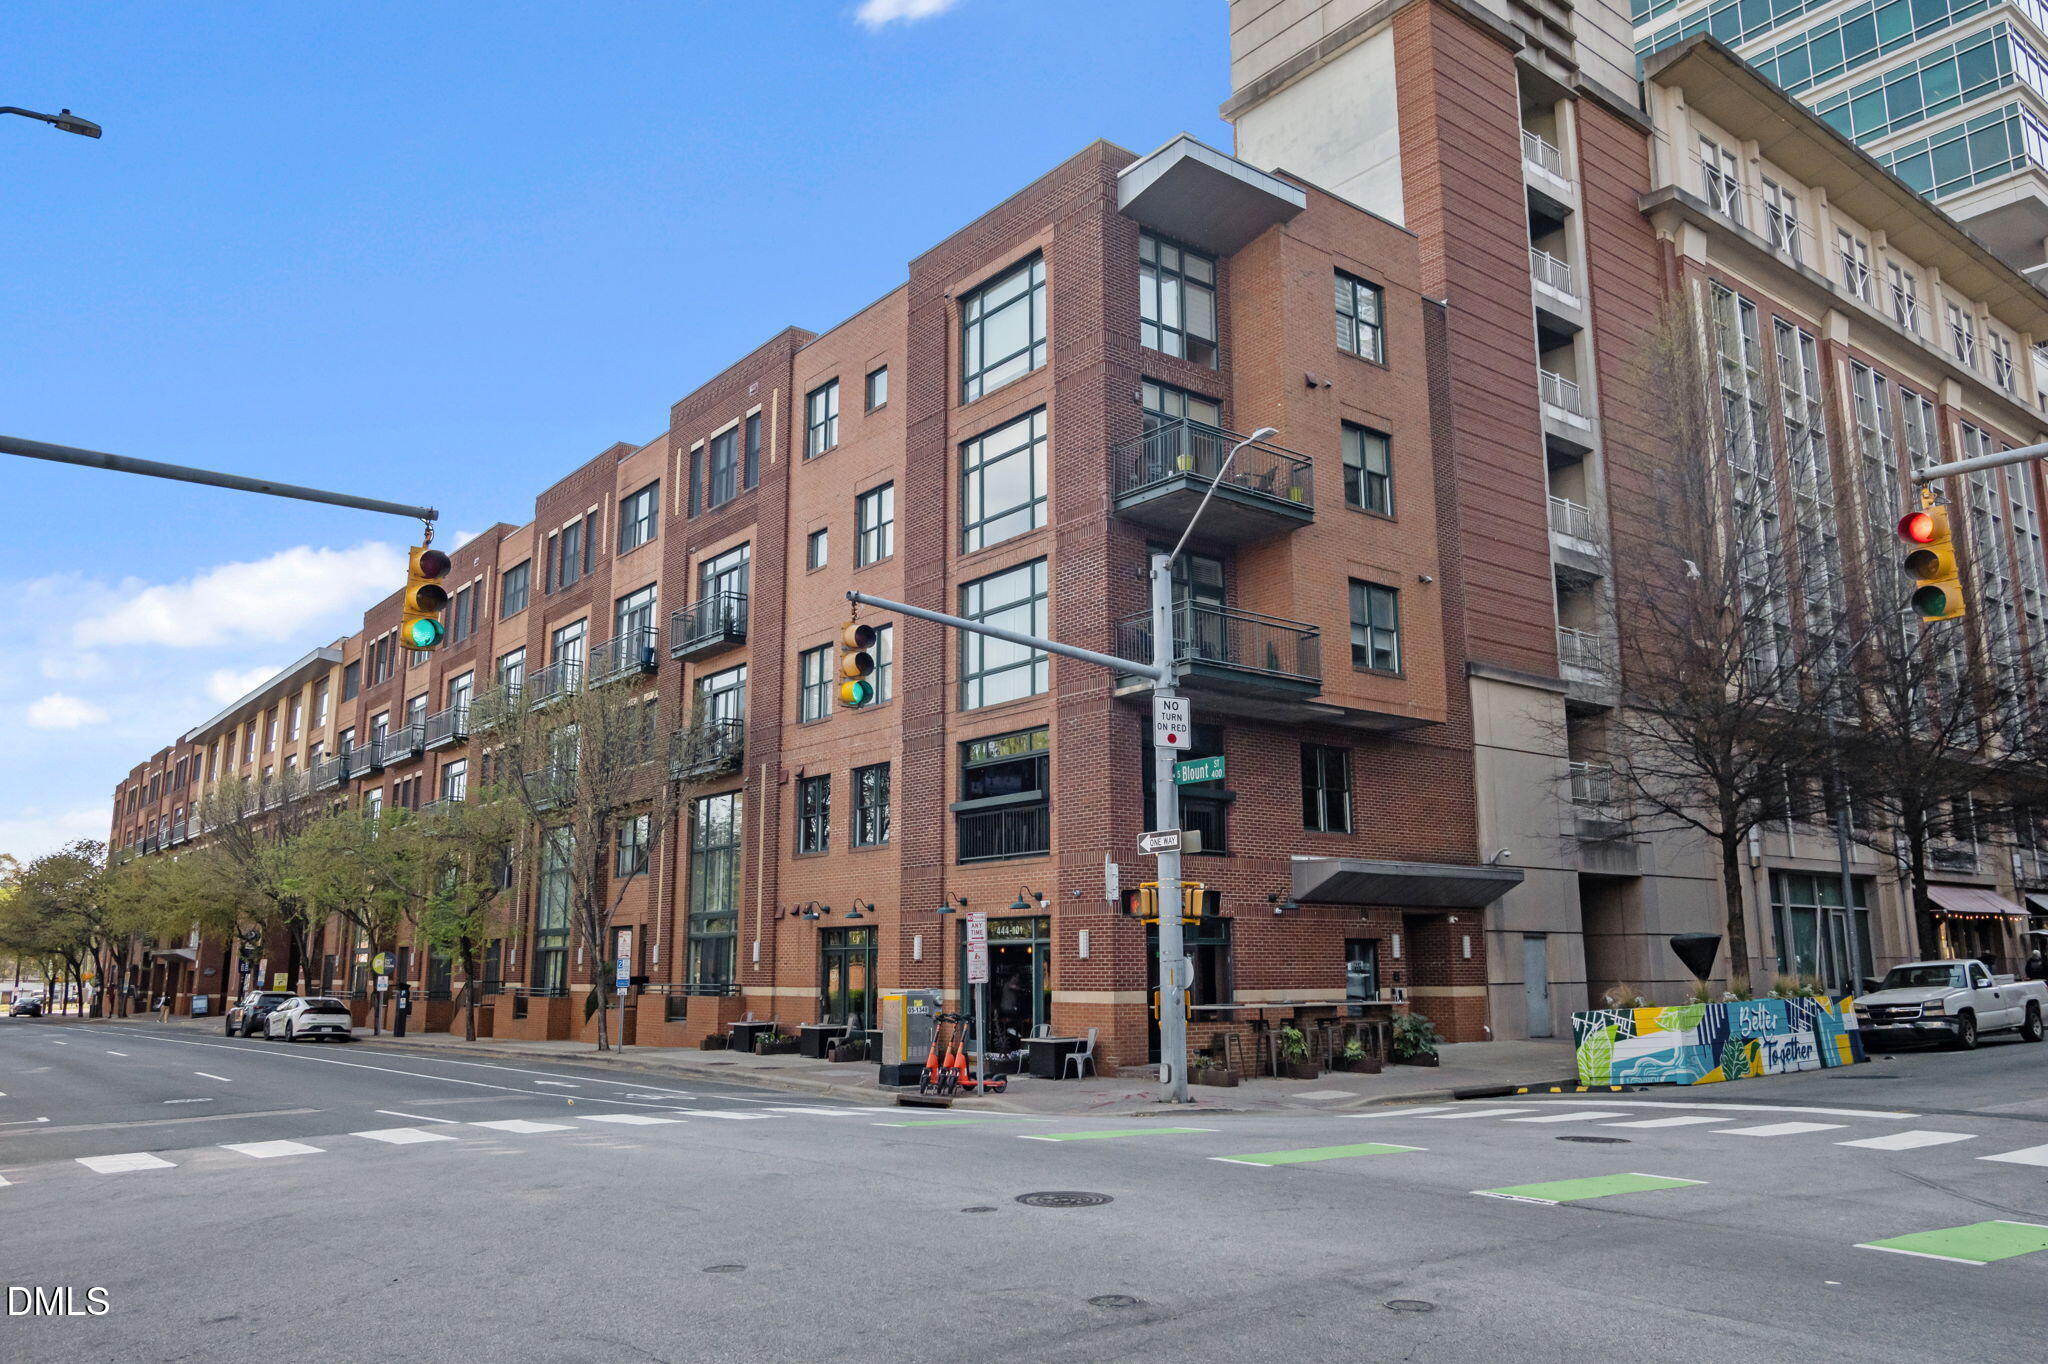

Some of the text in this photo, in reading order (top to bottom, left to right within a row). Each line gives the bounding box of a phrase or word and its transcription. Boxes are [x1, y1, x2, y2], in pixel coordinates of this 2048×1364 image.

[1163, 701, 1179, 711] NO
[1162, 713, 1182, 721] TURN
[1157, 722, 1187, 732] ON RED
[1176, 759, 1220, 782] S Blount ST
[1211, 768, 1223, 778] 400
[1150, 836, 1176, 847] ONE WAY
[1739, 1003, 1778, 1041] Better
[1762, 1037, 1813, 1070] Together
